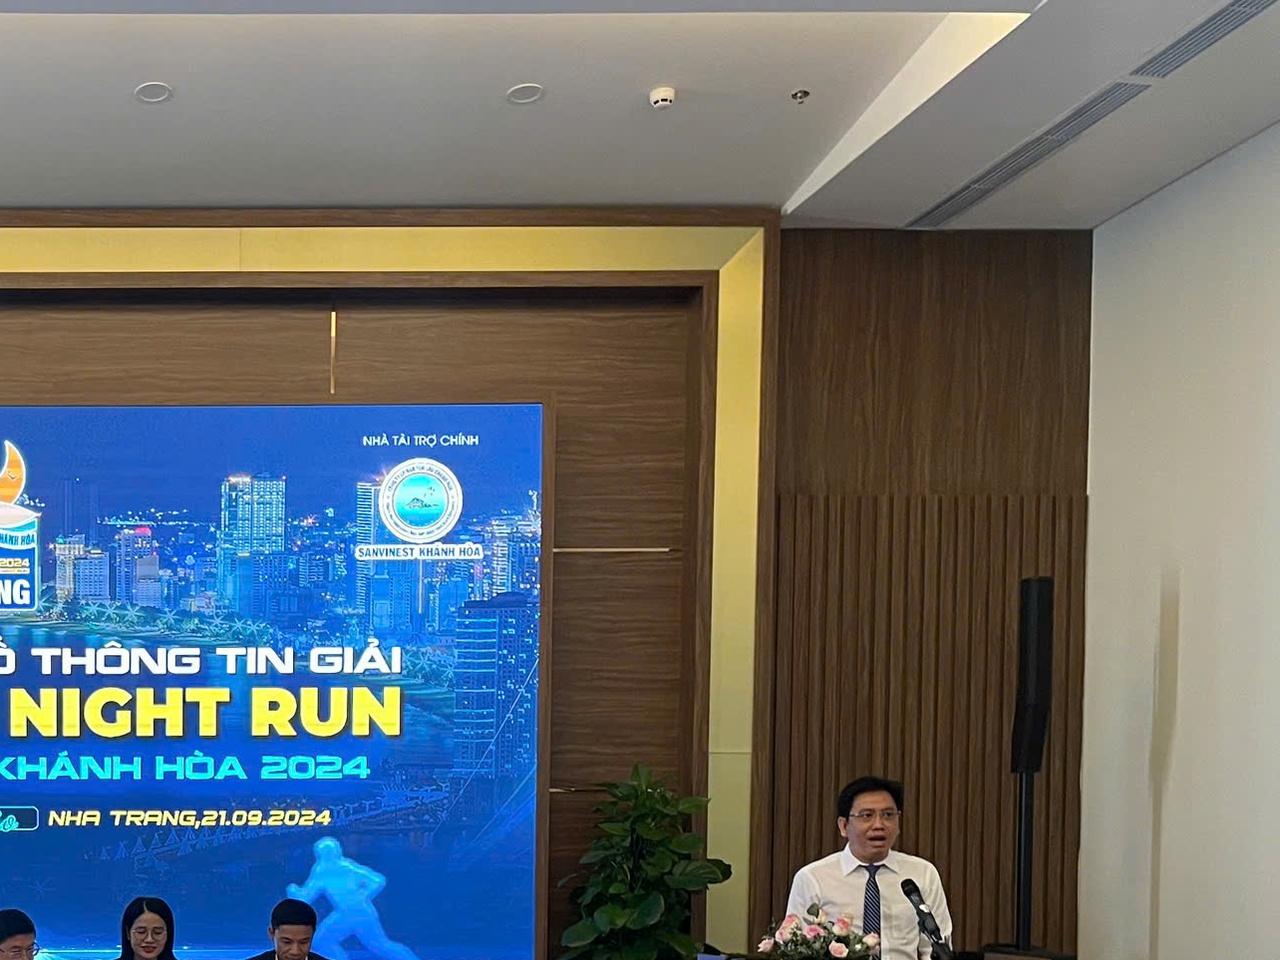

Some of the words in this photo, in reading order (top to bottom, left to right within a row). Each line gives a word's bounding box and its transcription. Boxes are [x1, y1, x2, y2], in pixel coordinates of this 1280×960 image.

[362, 433, 390, 446] NHÀ
[392, 433, 411, 446] TÀI
[414, 433, 438, 448] TRỢ
[440, 432, 479, 446] CHÍNH
[359, 546, 415, 558] SANVINEST
[419, 544, 455, 557] KHÁNH
[459, 544, 480, 557] HÒA
[31, 642, 201, 675] THÔNG
[219, 647, 295, 675] TIN
[310, 637, 402, 675] GIẢI
[9, 686, 231, 738] NIGHT
[252, 686, 402, 738] RUN
[156, 749, 247, 781] HÒA
[261, 755, 371, 780] 2024
[48, 809, 101, 827] NHA
